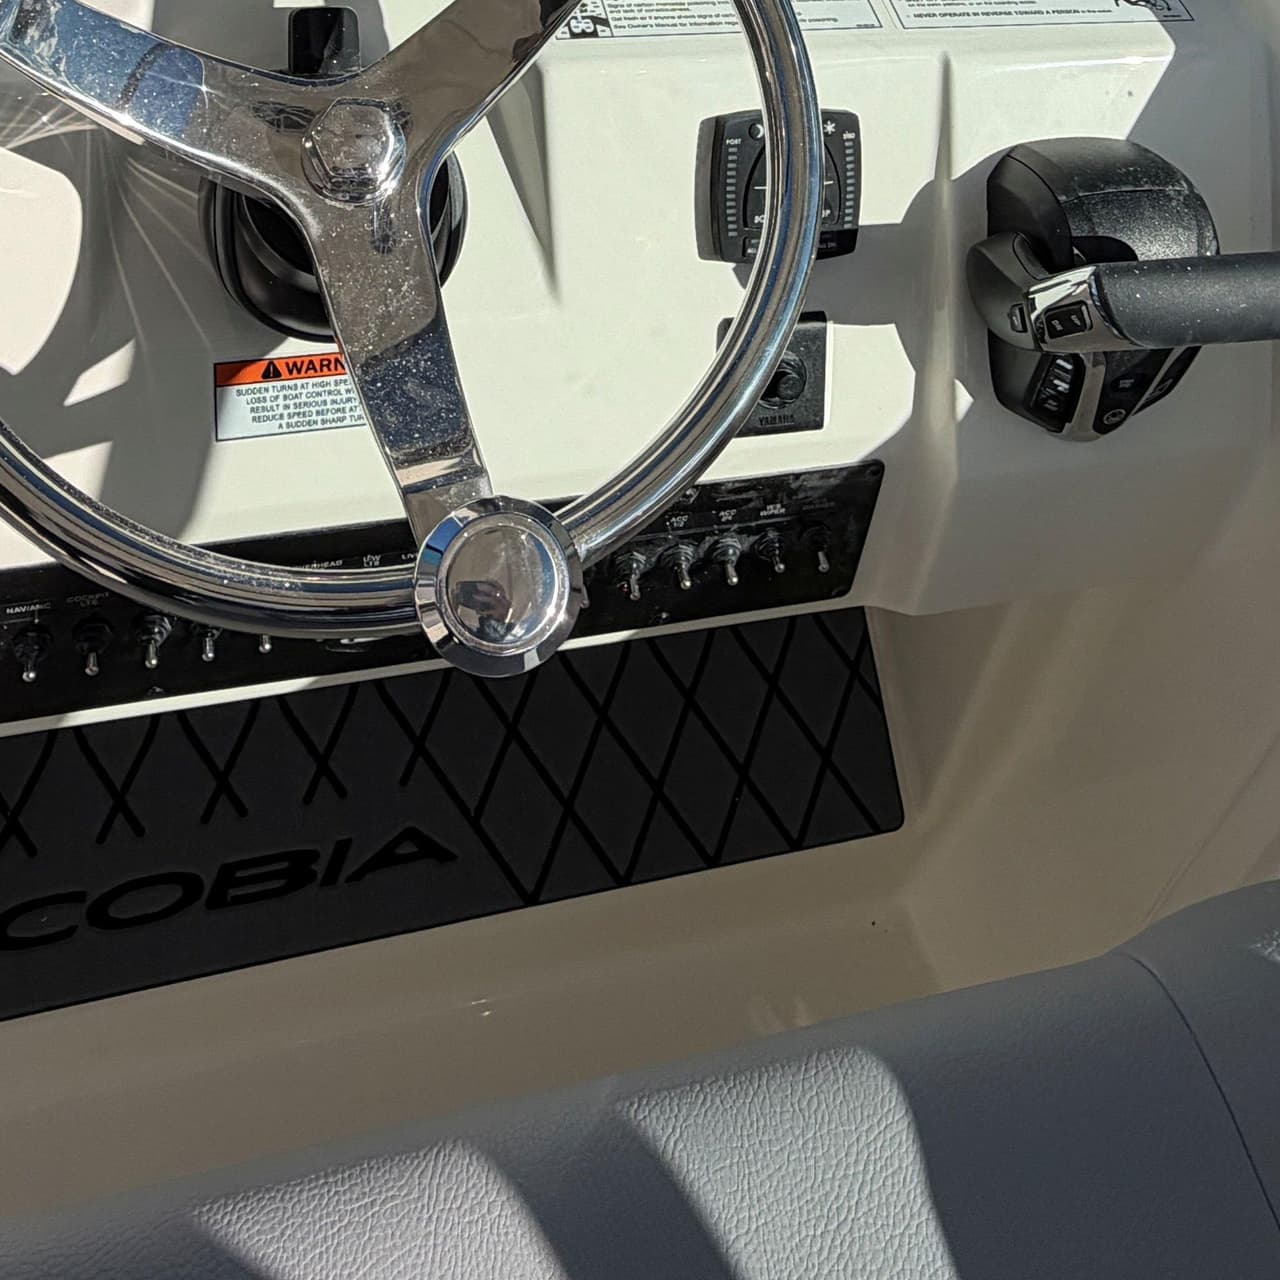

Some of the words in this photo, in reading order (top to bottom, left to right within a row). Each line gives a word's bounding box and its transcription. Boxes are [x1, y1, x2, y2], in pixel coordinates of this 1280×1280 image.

[285, 357, 346, 376] WARN
[236, 386, 270, 397] SUDDEN
[272, 383, 299, 393] TURNS
[300, 382, 309, 390] AT
[312, 380, 331, 389] HIGH
[246, 396, 267, 405] LOSS
[269, 394, 280, 403] OF
[283, 392, 303, 401] BOAT
[305, 389, 343, 400] CONTROL
[250, 404, 280, 414] RESULT
[282, 403, 291, 411] IN
[293, 399, 328, 410] SERIOUS
[252, 413, 285, 423] REDUCE
[287, 410, 313, 420] SPEED
[315, 407, 347, 417] BEFORE
[278, 422, 284, 430] A
[286, 419, 318, 429] SUDDEN
[321, 415, 347, 426] SHARP
[349, 414, 365, 422] TUR
